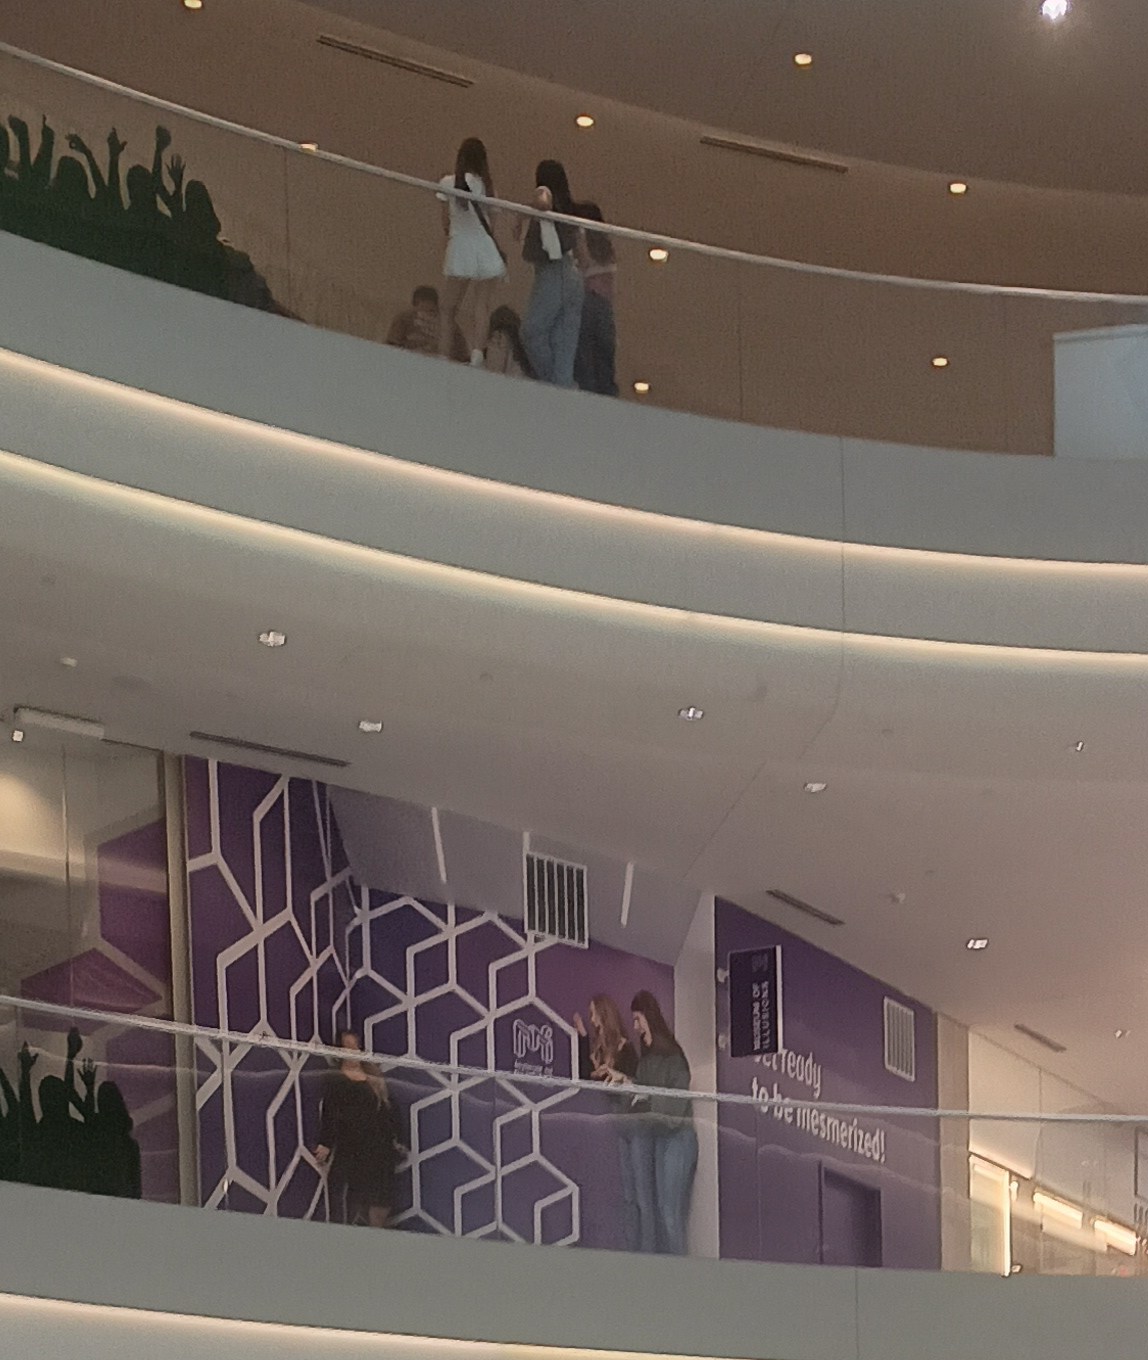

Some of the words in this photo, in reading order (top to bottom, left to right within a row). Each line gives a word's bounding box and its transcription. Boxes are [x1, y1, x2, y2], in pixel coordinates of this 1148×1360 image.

[781, 1049, 821, 1099] ready
[752, 1077, 769, 1113] to
[773, 1083, 793, 1123] be
[796, 1106, 886, 1164] mesmerized!
